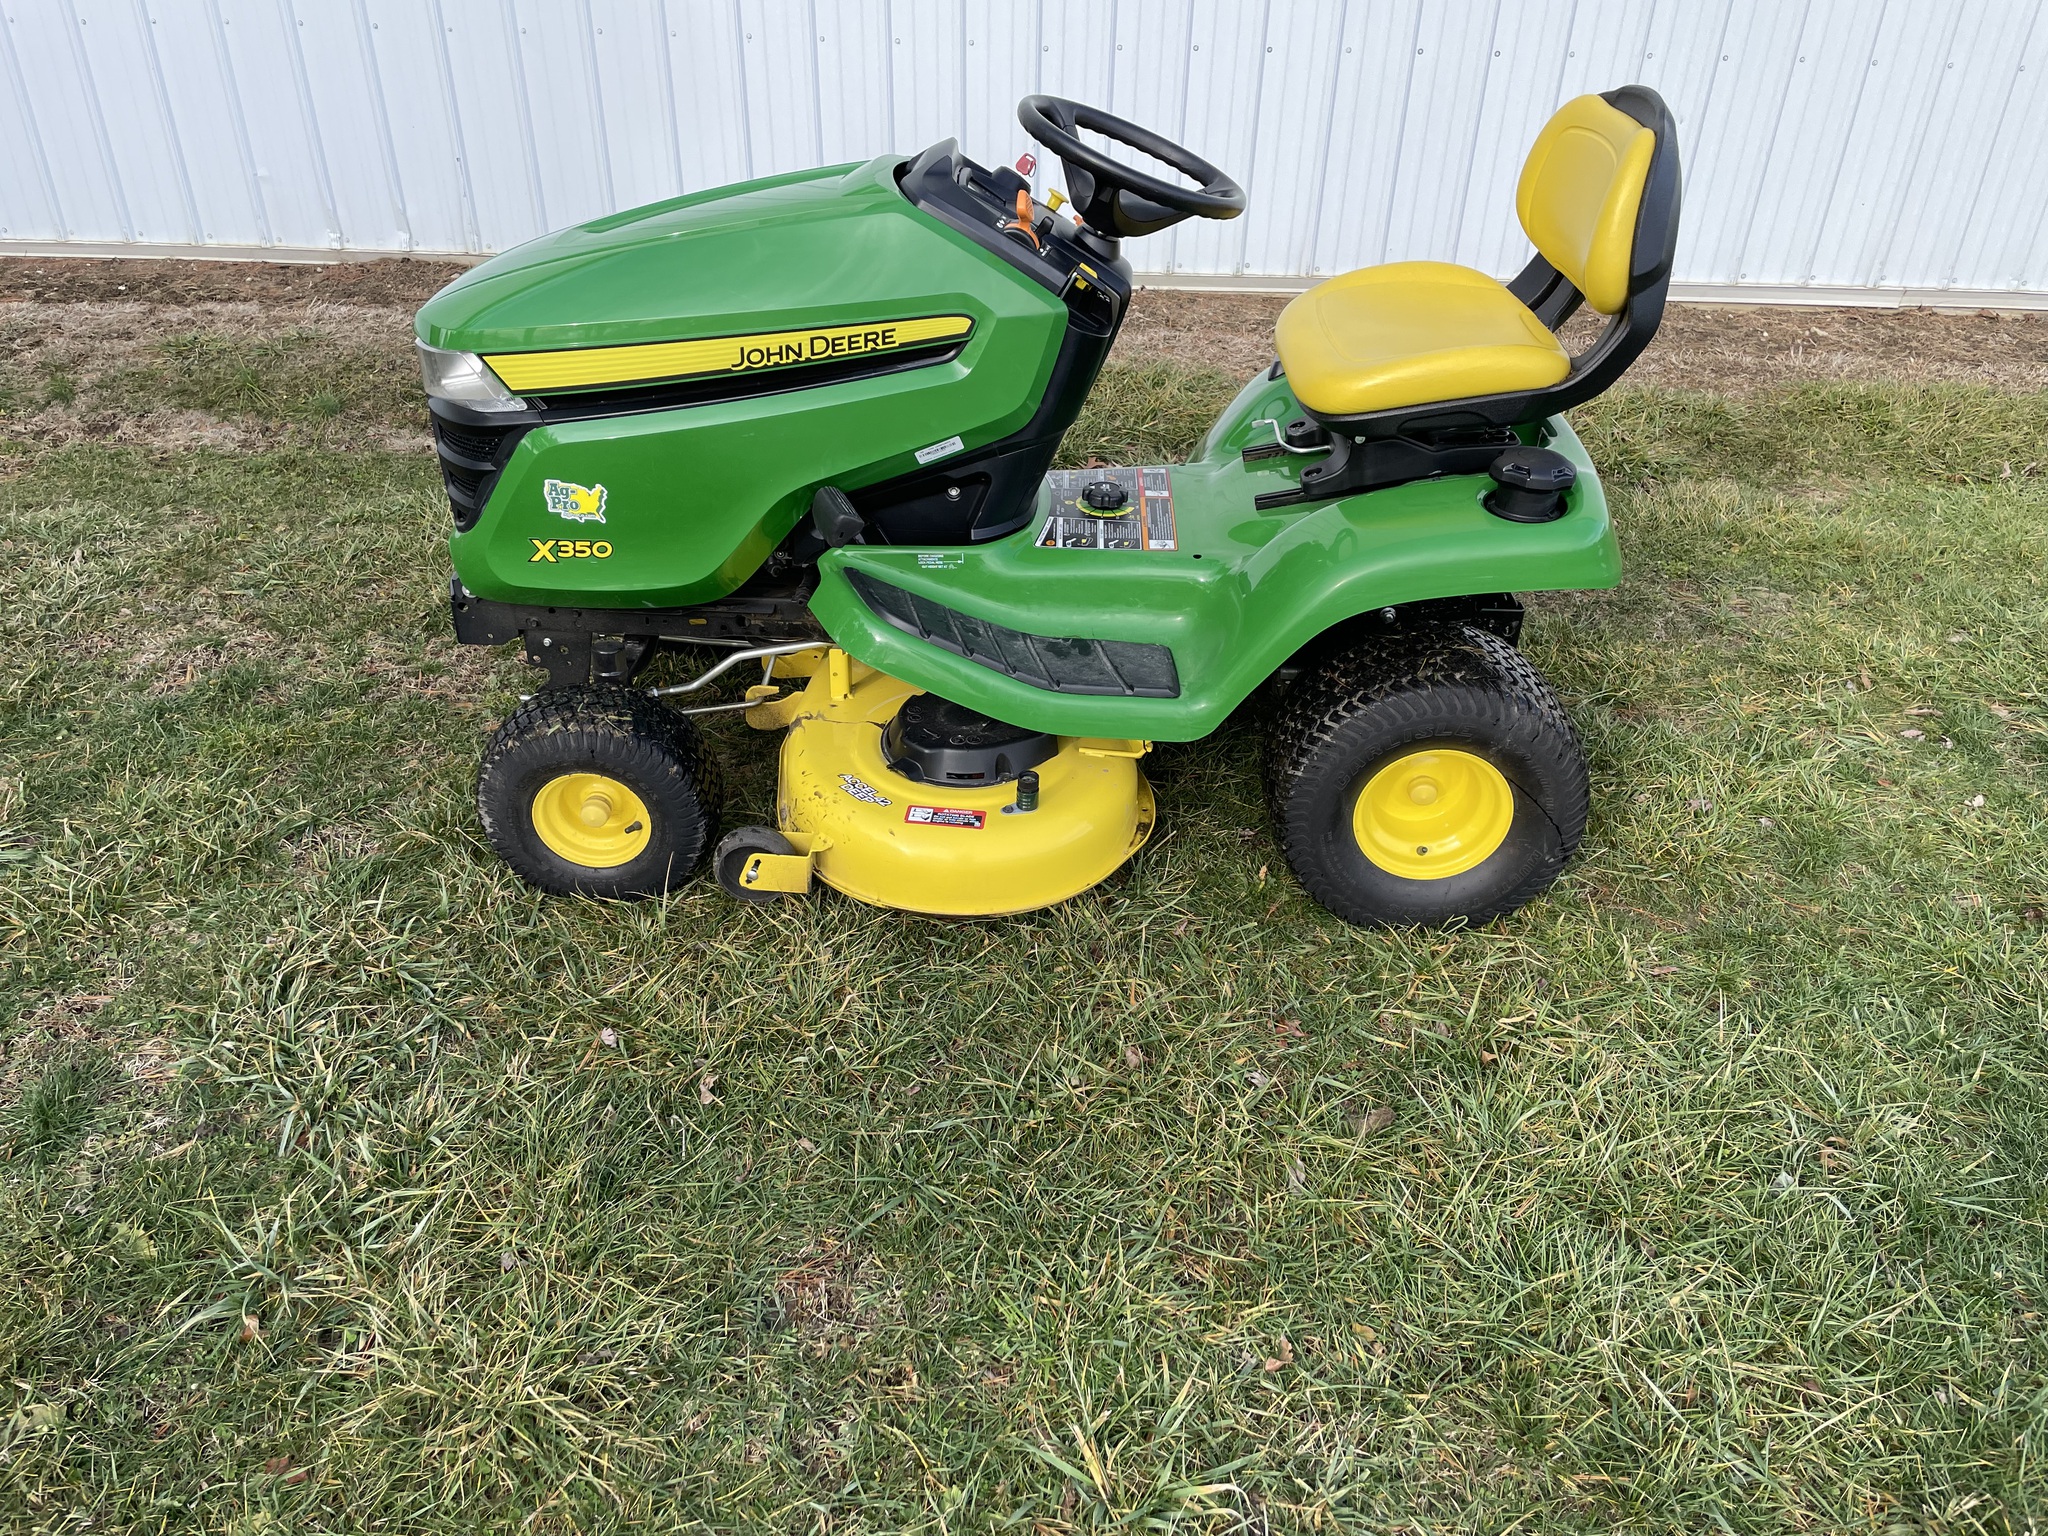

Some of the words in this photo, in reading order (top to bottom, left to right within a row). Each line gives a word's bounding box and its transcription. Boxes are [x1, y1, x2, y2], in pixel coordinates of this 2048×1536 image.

[731, 342, 803, 368] JOHN
[810, 328, 897, 357] DEERE
[548, 482, 576, 499] Ag-
[550, 496, 580, 510] Pro
[528, 538, 613, 563] X350
[1335, 722, 1476, 790] CARLISLE
[837, 773, 878, 797] ACCEL
[838, 783, 875, 803] DEEP
